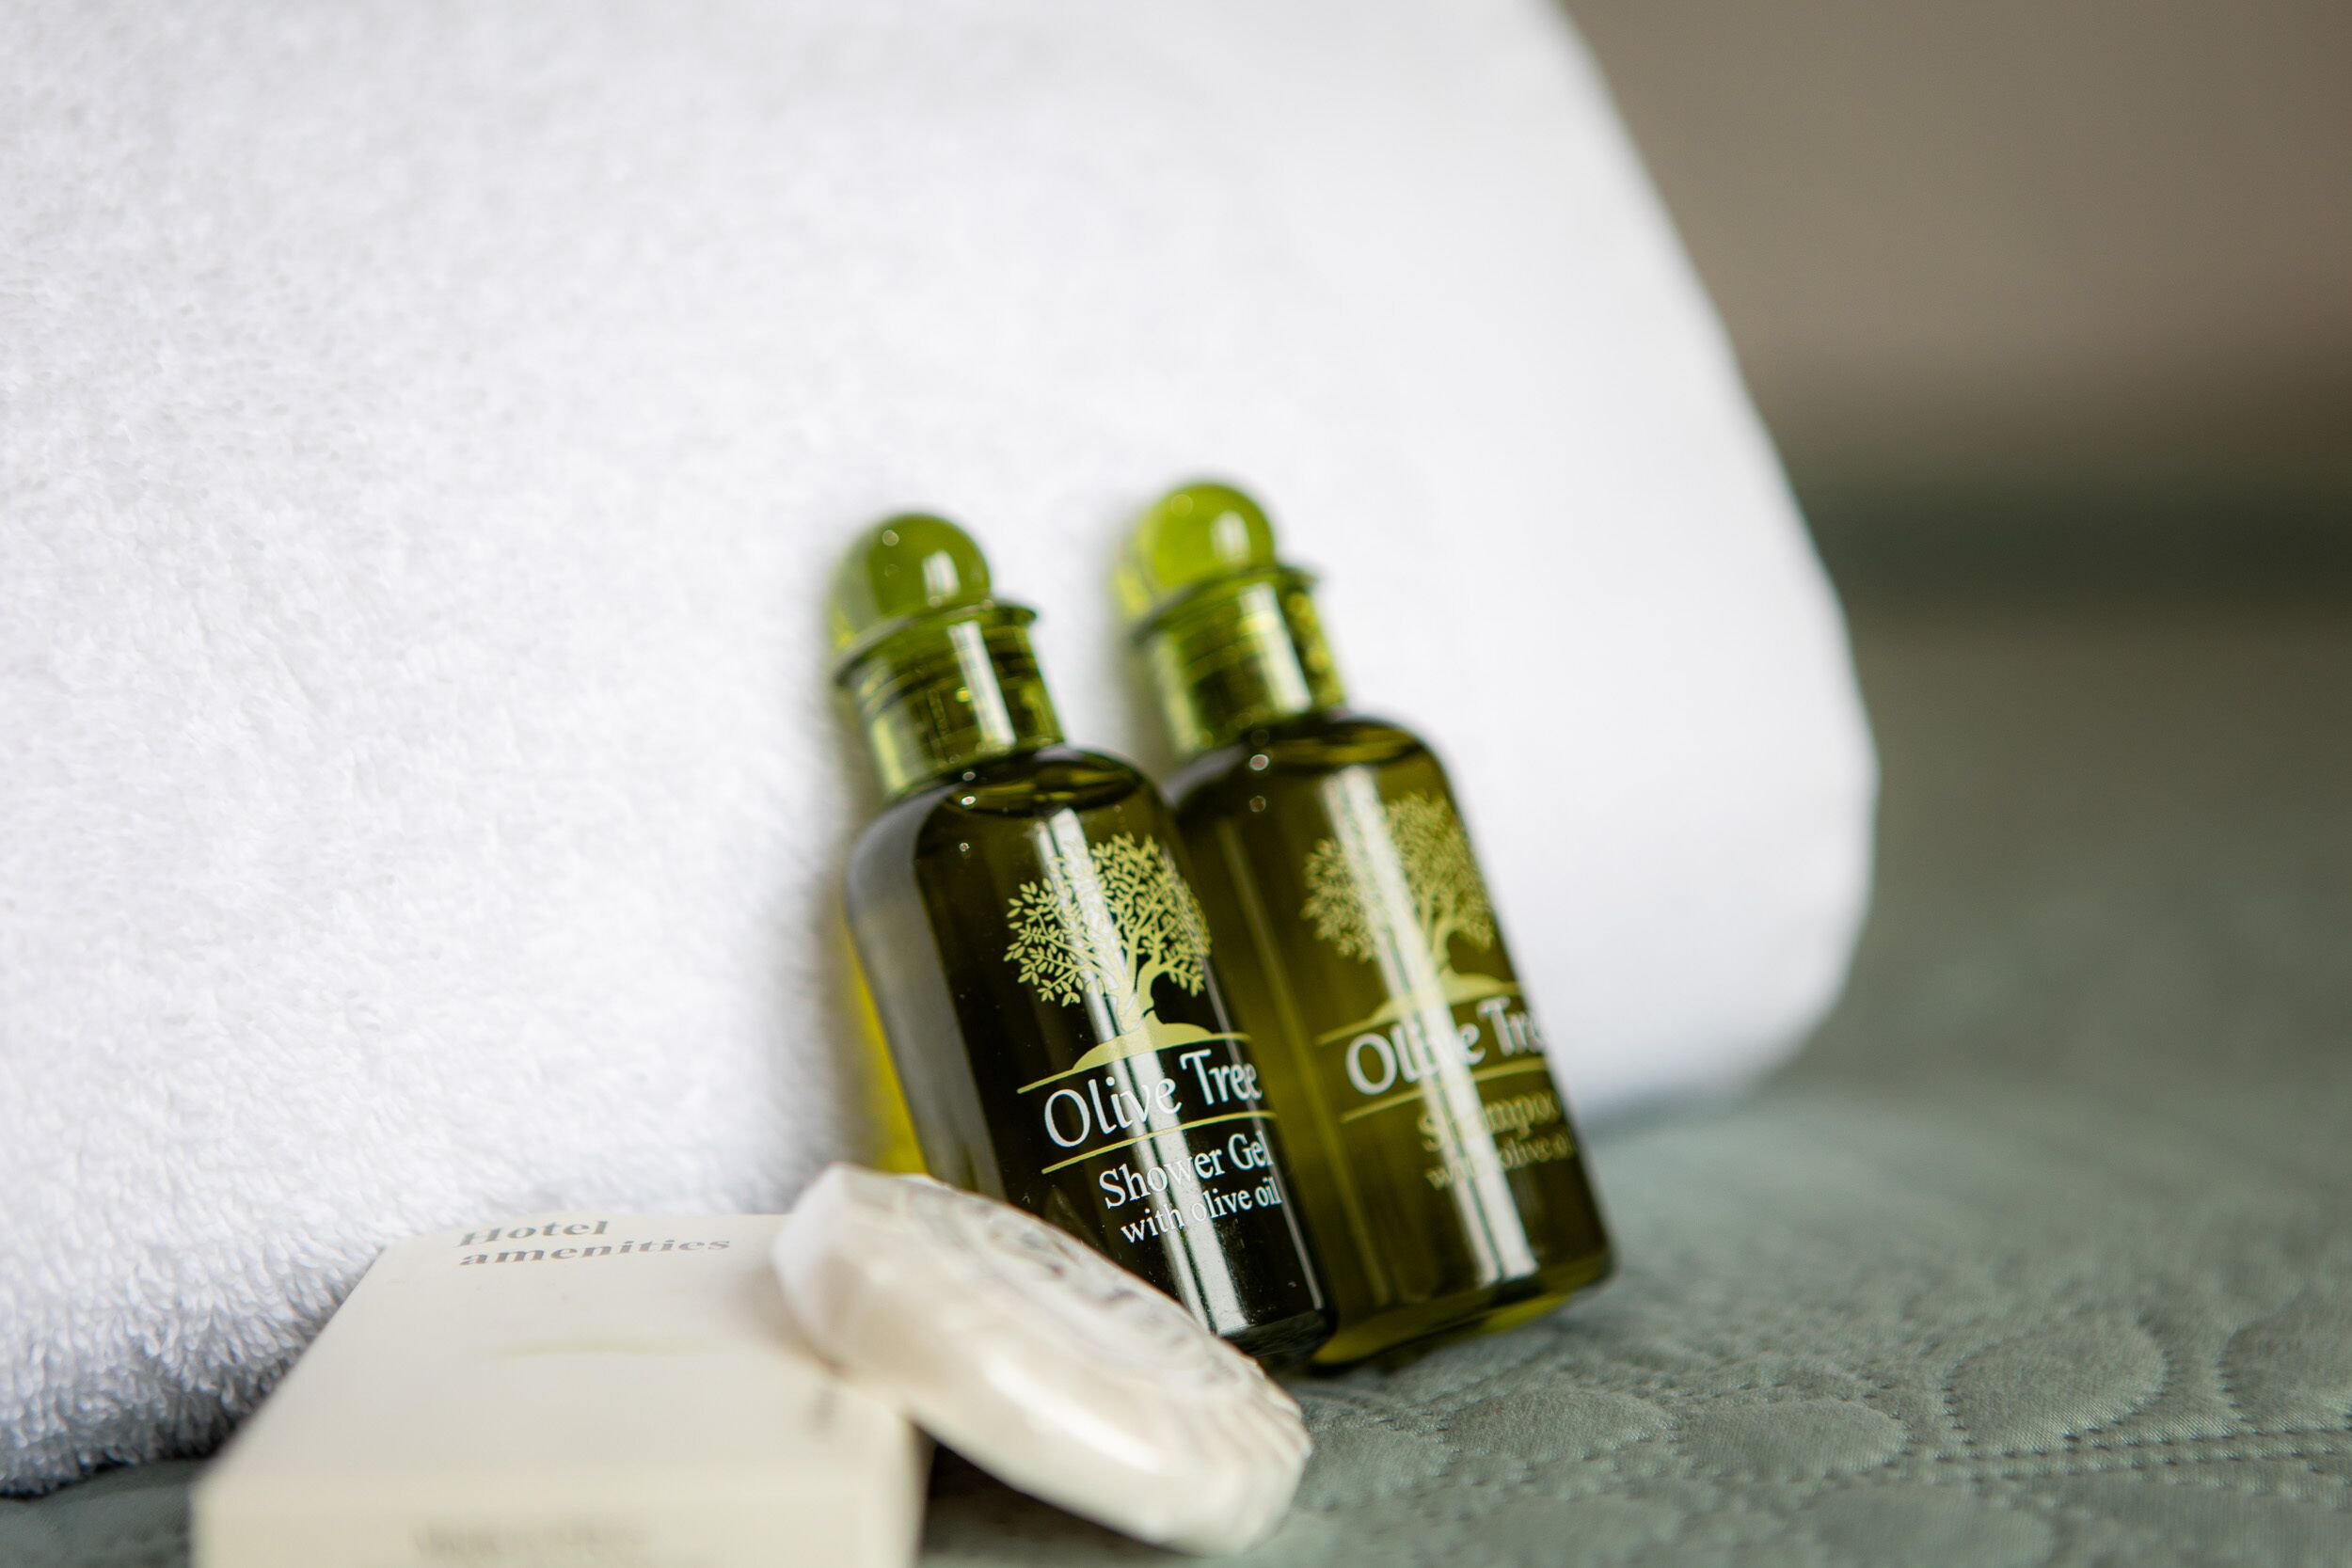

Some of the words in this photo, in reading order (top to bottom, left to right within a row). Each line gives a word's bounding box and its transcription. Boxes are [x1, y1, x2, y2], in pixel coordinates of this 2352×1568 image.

[1344, 1018, 1486, 1096] Olie
[1475, 995, 1548, 1058] Tre
[1043, 1076, 1183, 1148] Olive
[1179, 1048, 1263, 1106] Tree
[1098, 1148, 1226, 1210] Shower
[1228, 1130, 1274, 1171] Gel
[453, 1219, 610, 1248] Hotel
[1120, 1204, 1185, 1244] with
[1190, 1187, 1253, 1223] olive
[1254, 1176, 1283, 1208] oil
[458, 1239, 731, 1266] amenities
